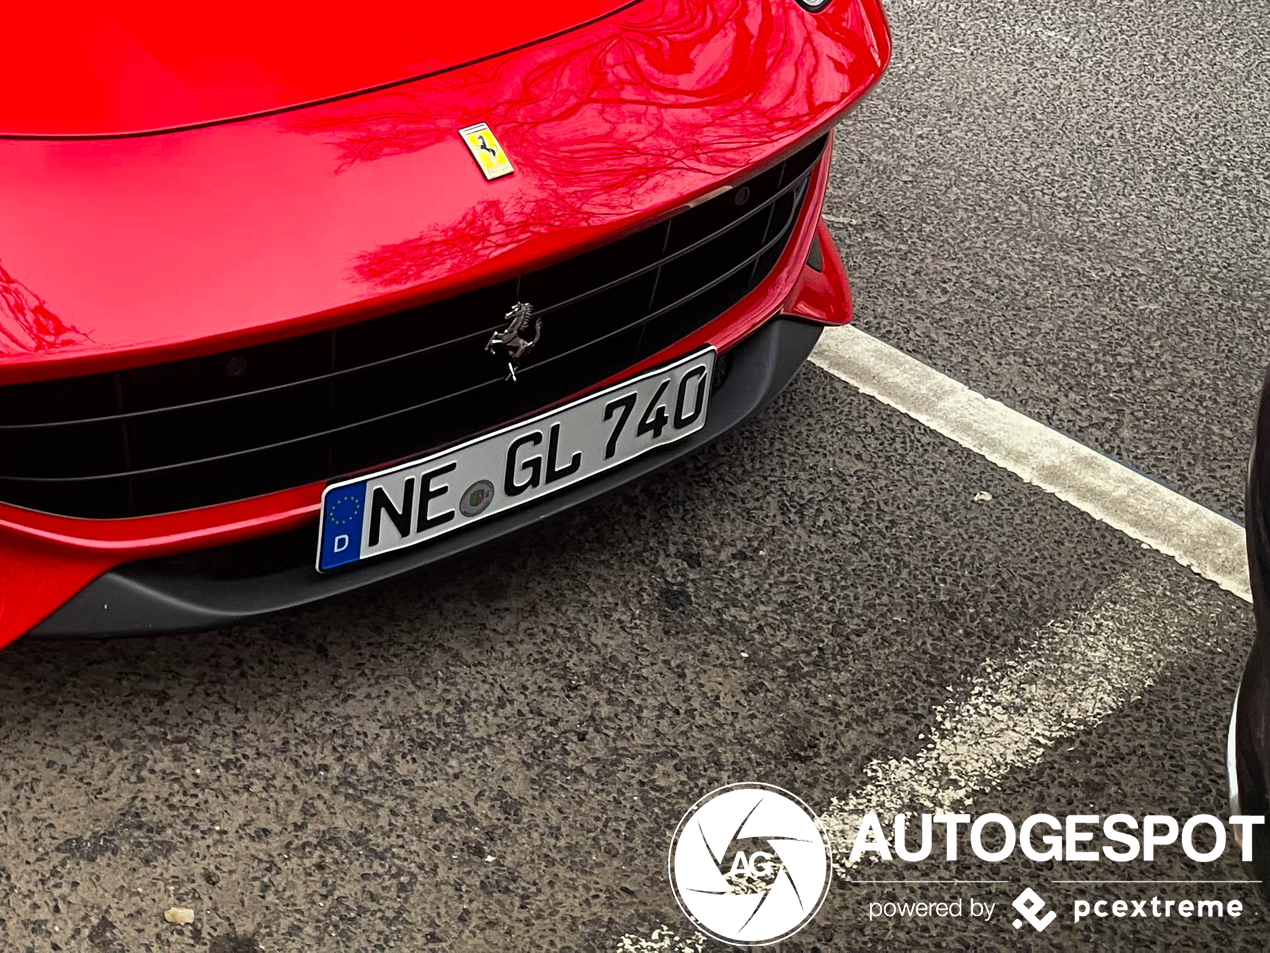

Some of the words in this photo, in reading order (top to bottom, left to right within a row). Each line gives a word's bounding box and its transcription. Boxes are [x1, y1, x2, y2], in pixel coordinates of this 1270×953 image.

[368, 461, 457, 547] NE
[504, 422, 582, 498] GL
[603, 364, 708, 461] 740
[333, 534, 349, 553] D
